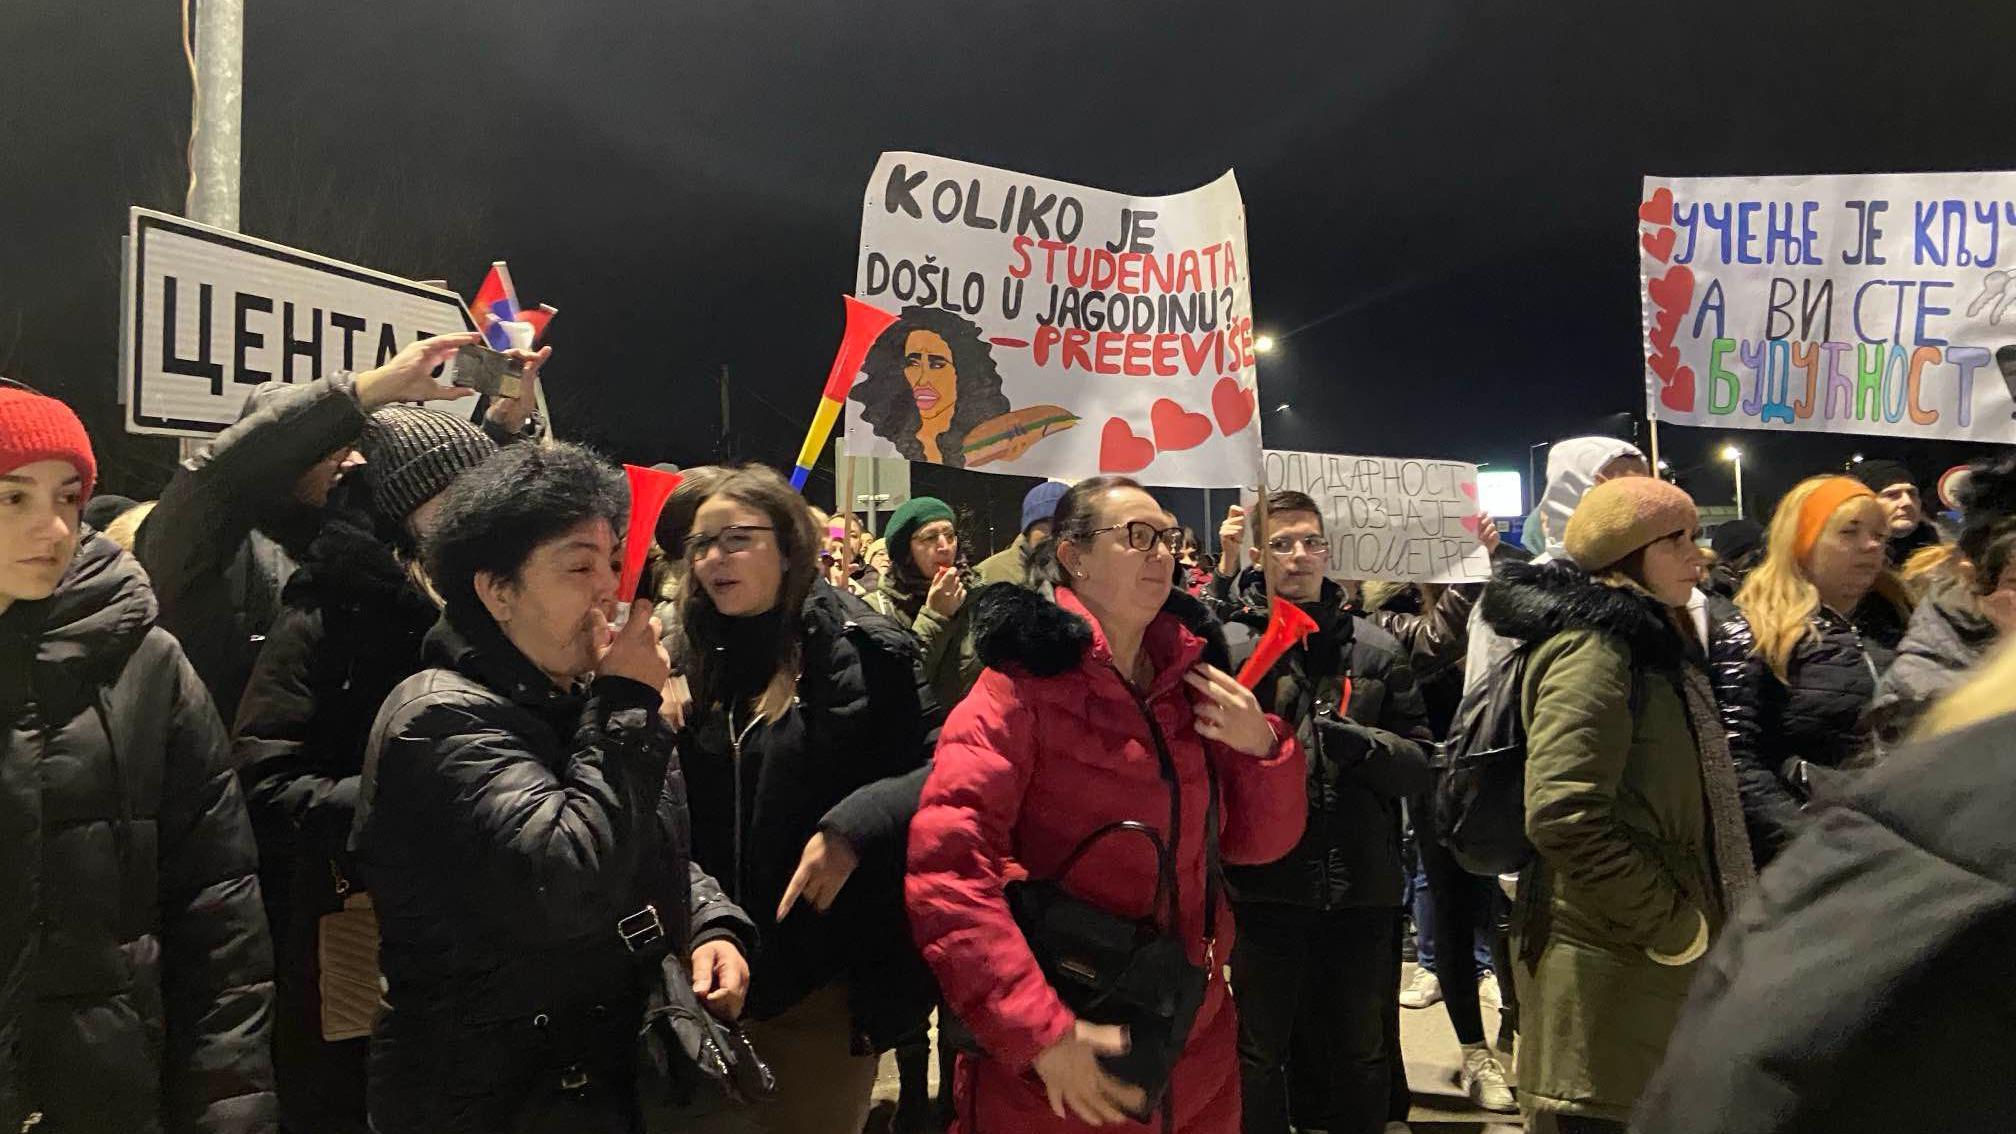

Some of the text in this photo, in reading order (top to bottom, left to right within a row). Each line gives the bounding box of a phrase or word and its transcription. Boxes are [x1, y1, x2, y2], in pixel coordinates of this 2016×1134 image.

[884, 163, 1158, 255] KOLIKO JE
[1673, 200, 1823, 265] УЧЕЊЕ
[1842, 200, 1888, 265] ЈЕ
[866, 252, 1234, 334] DOŠLO U JAGODINU?
[1008, 235, 1238, 295] STUDENATA
[1692, 278, 1954, 346] А ВИ СТЕ
[1247, 452, 1466, 498] ОЛИДАРНОСТ
